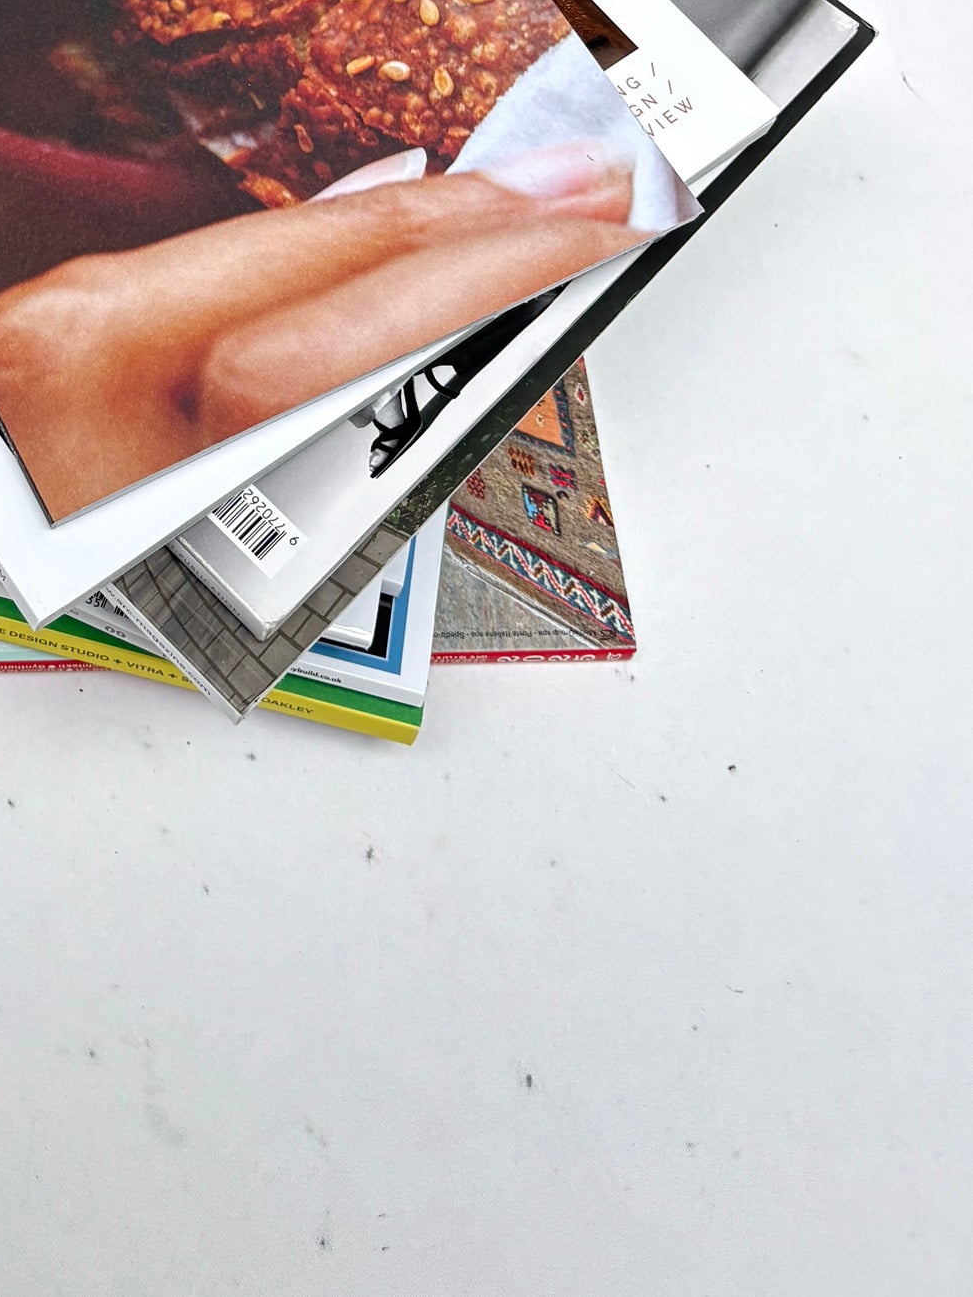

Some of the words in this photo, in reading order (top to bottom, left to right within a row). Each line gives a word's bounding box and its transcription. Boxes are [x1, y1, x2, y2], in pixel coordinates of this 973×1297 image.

[242, 488, 287, 533] 770262
[288, 535, 300, 546] 9
[8, 629, 58, 649] DESIGN
[59, 642, 110, 663] STUDIO
[125, 659, 164, 677] VITRA
[260, 695, 313, 716] OAKLEY
[290, 663, 341, 686] ybuild.co.uk
